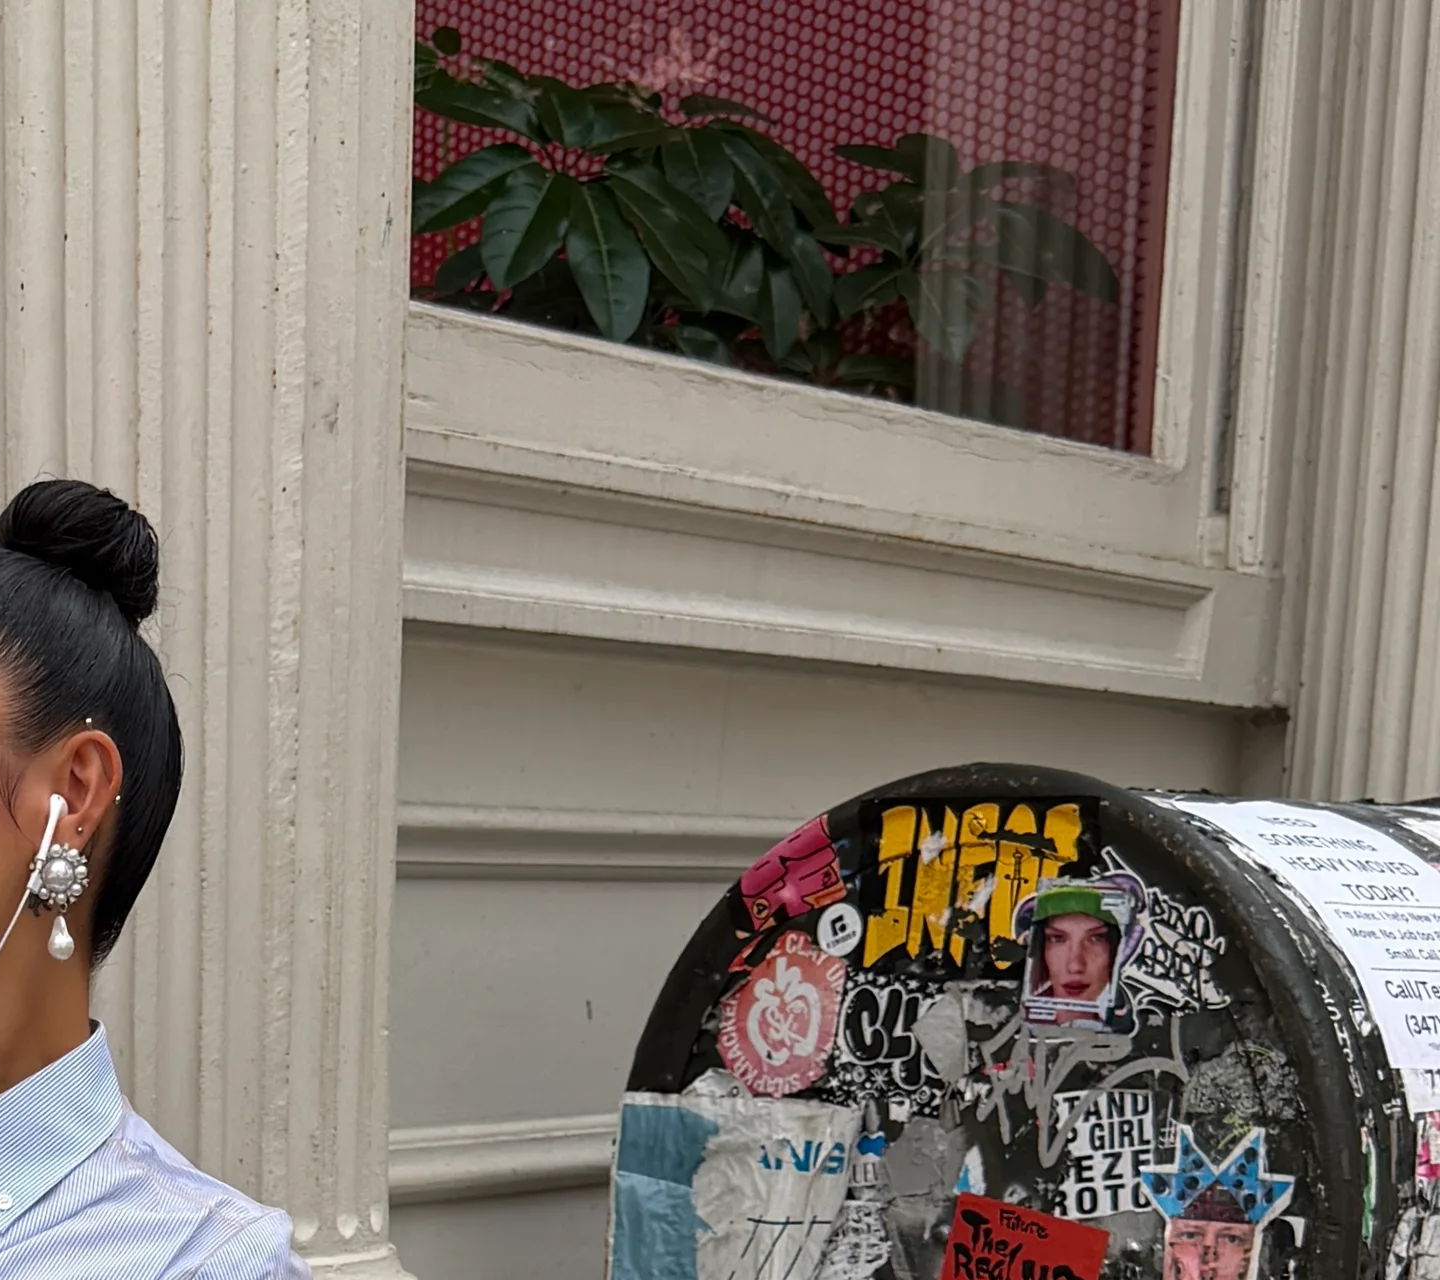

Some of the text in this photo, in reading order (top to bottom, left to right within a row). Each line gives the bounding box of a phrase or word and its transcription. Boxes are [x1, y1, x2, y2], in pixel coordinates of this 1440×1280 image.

[1258, 832, 1379, 853] SOMETHING
[1281, 855, 1420, 877] HEAVY MOVED
[1342, 883, 1421, 903] TODAY?
[1057, 1093, 1151, 1123] TAND
[1088, 1119, 1151, 1153] GIRL
[961, 1208, 1010, 1258] The
